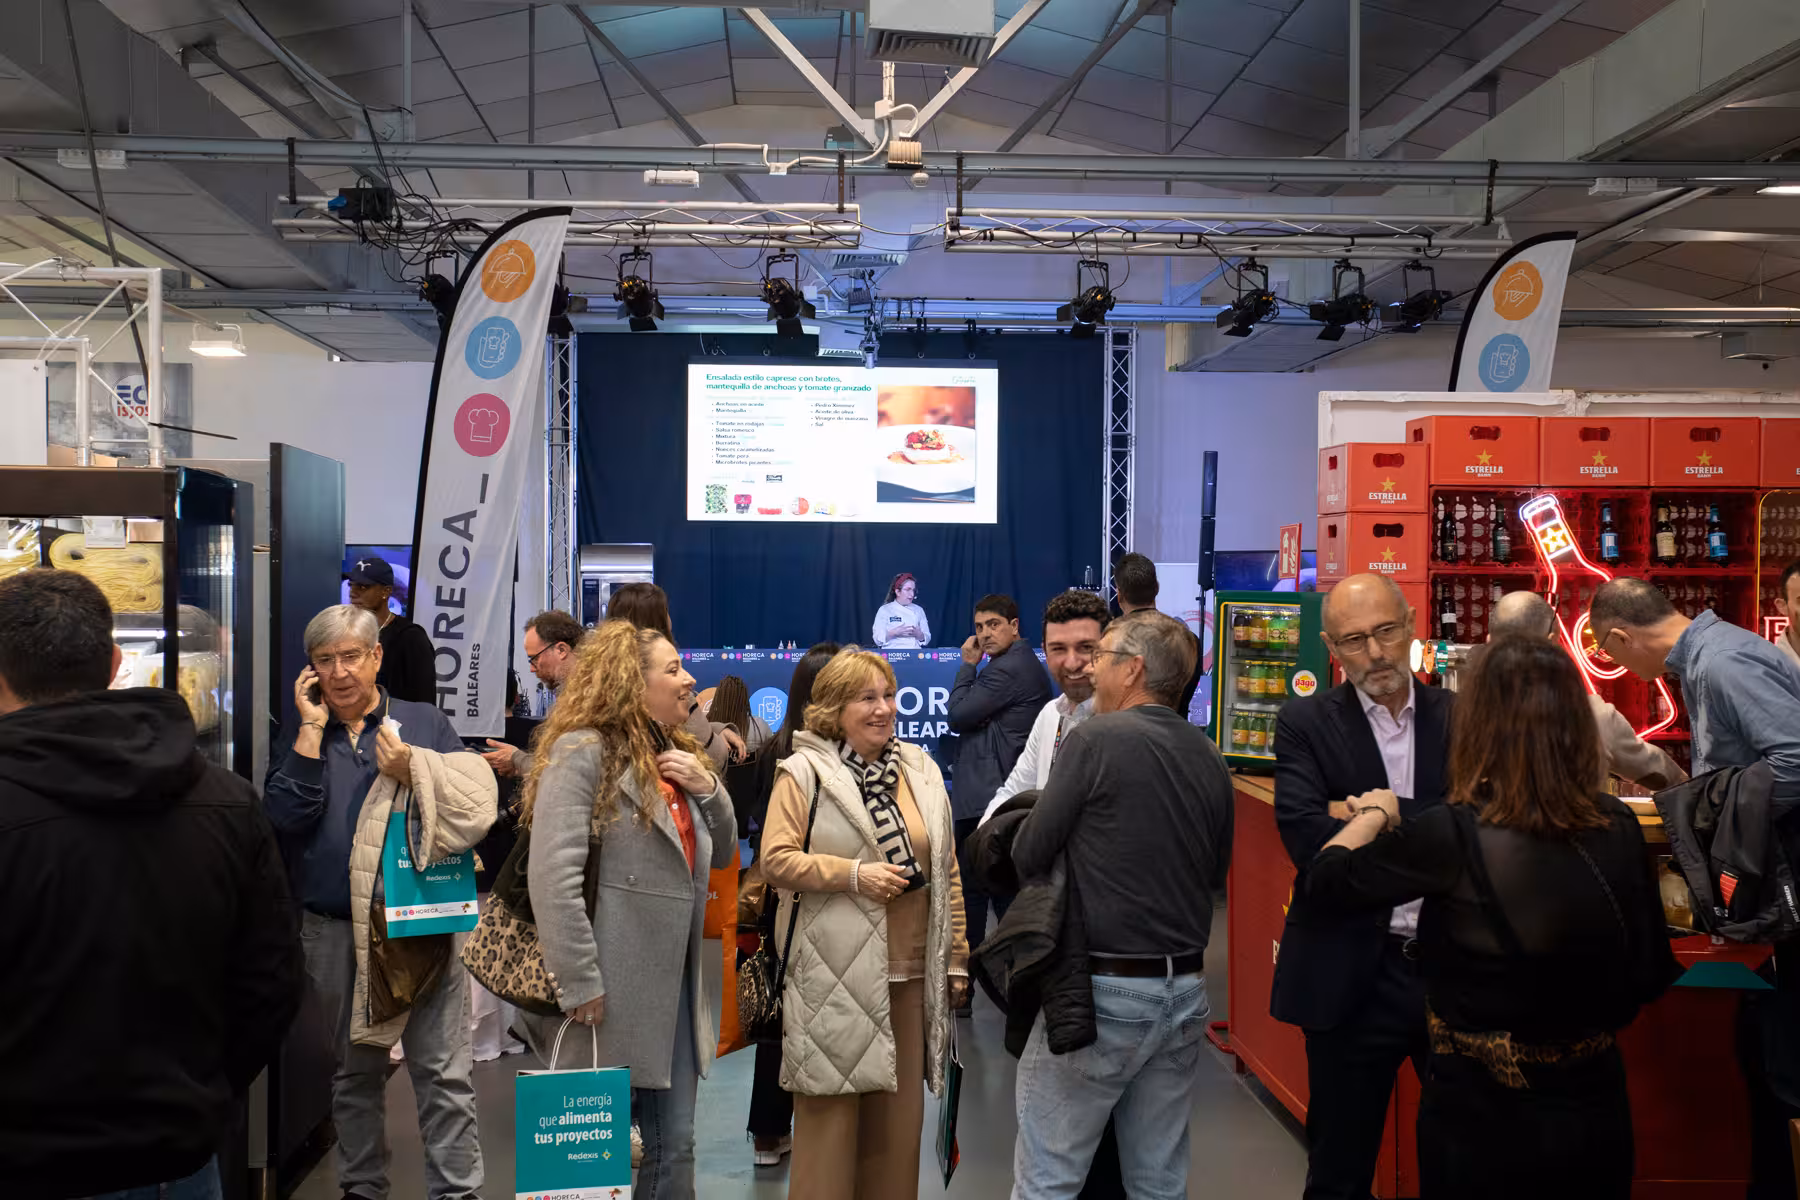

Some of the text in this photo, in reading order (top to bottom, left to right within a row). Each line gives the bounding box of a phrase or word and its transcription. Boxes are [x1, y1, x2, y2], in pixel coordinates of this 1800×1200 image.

[766, 376, 796, 384] caprese
[815, 375, 842, 383] brotes,
[706, 383, 750, 391] mantequilla
[833, 384, 872, 392] granizado
[1580, 466, 1618, 474] ESTRELLA
[1369, 492, 1406, 500] ESTRELLA
[466, 643, 481, 718] BALEARES
[564, 1092, 612, 1109] La energía
[539, 1110, 612, 1130] que alimenta
[534, 1128, 612, 1146] tus proyectos
[568, 1152, 598, 1160] Redexis
